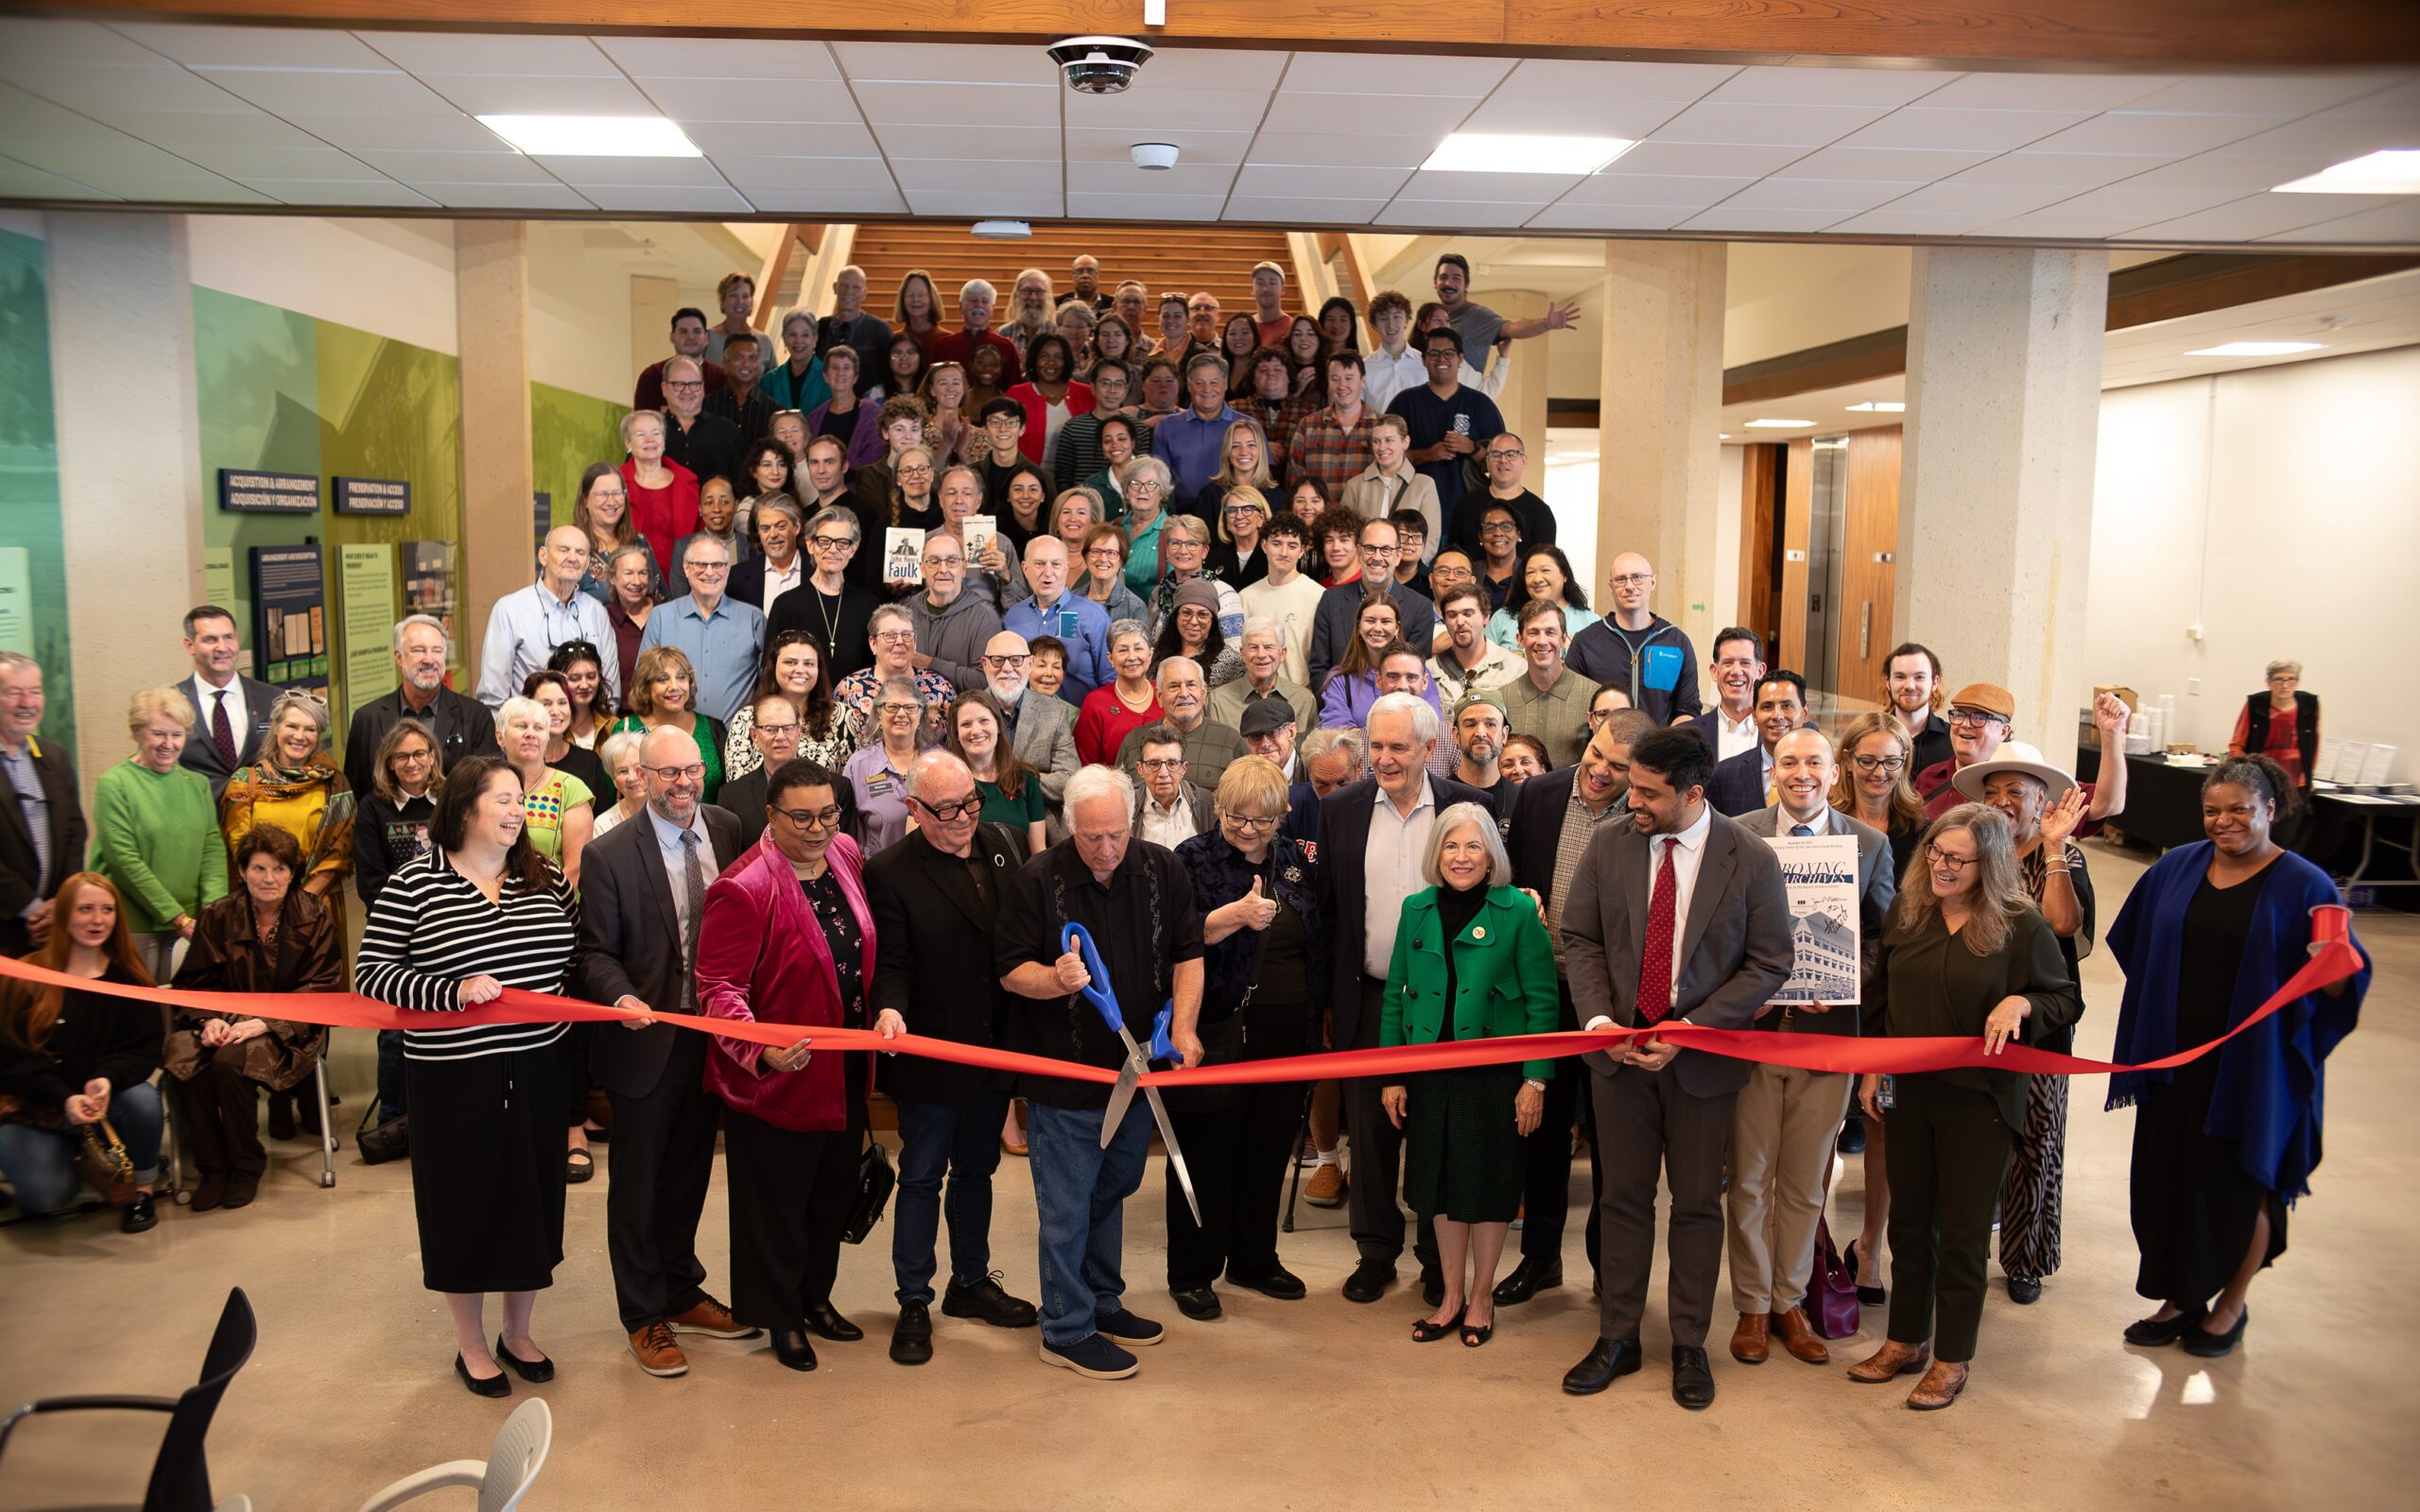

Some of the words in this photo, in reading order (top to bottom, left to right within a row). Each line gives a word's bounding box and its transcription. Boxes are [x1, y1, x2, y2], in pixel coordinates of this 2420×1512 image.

[229, 475, 269, 490] ACQUISITION
[275, 478, 317, 491] ARRANGEMENT
[348, 482, 383, 494] PRESERVATION
[387, 485, 404, 495] ACCESS
[230, 491, 270, 507] ADQUISICIÓN
[275, 493, 318, 507] ORGANIZACIÓN
[387, 499, 404, 509] ACCESO
[889, 561, 918, 578] Faulk
[1780, 861, 1845, 874] BOXING
[1785, 874, 1845, 884] ARCHIVES
